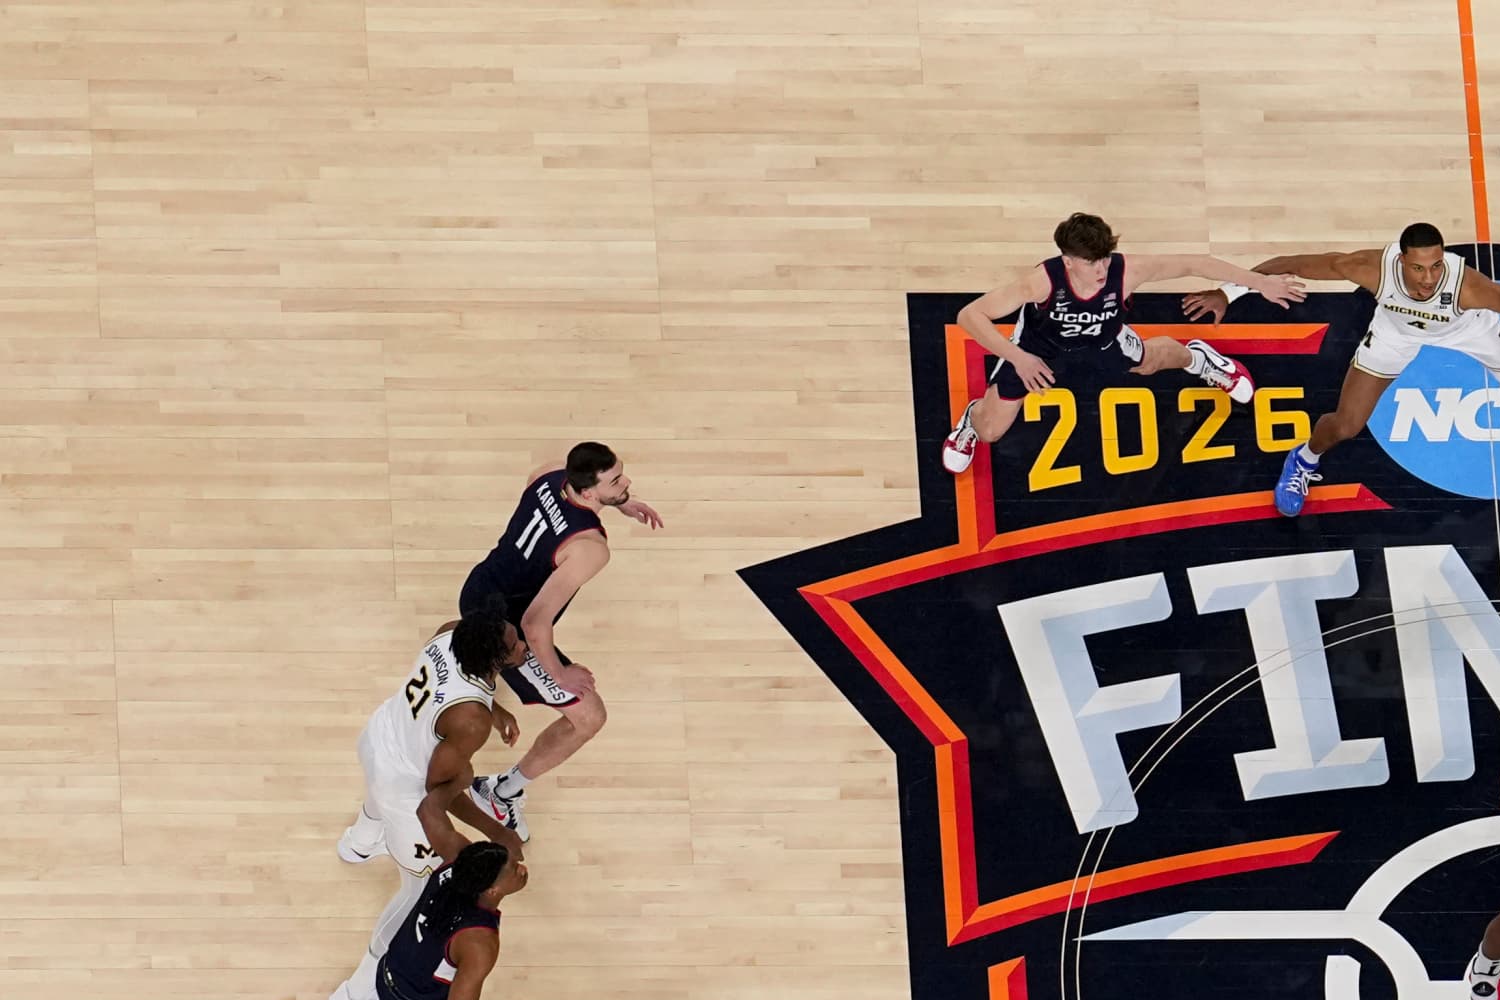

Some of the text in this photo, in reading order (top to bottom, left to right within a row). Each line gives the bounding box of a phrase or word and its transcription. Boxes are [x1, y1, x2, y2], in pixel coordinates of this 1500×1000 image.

[1049, 308, 1119, 323] UCONN
[1060, 323, 1103, 338] 24
[1383, 303, 1450, 323] MICHIGAN
[1407, 320, 1427, 330] 4
[1024, 387, 1312, 493] 2026
[535, 481, 569, 536] KARABAN
[514, 508, 549, 560] 11
[425, 644, 449, 687] JOHNSON
[405, 665, 430, 720] 21
